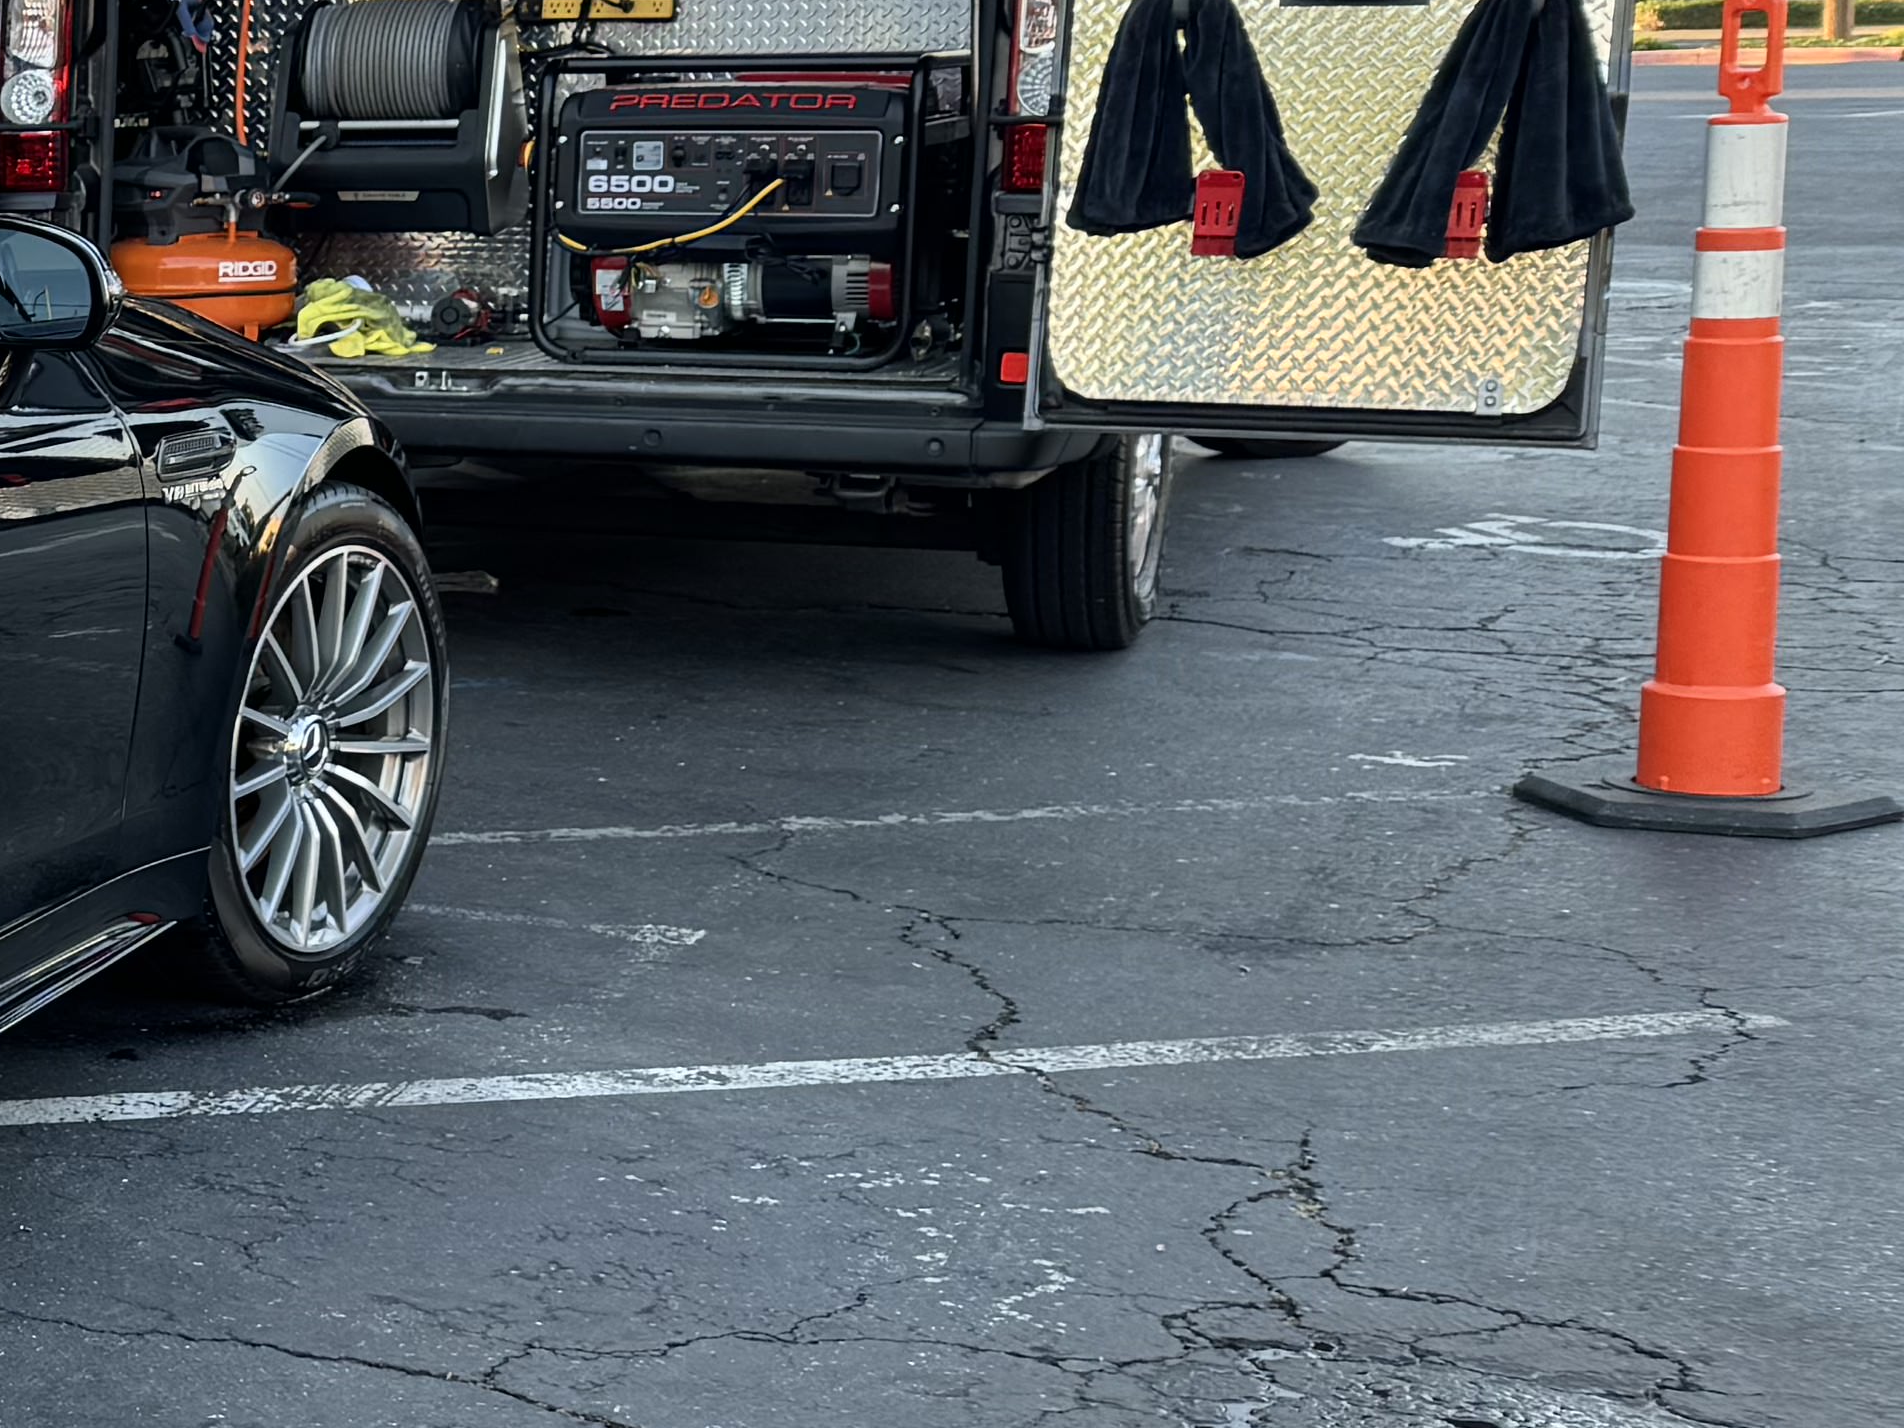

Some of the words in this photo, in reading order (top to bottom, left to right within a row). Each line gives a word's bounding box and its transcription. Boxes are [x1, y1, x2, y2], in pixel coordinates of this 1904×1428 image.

[609, 92, 857, 111] PREDATOR
[588, 174, 675, 193] 6500
[586, 197, 642, 210] 5500
[218, 260, 277, 277] RIDGID
